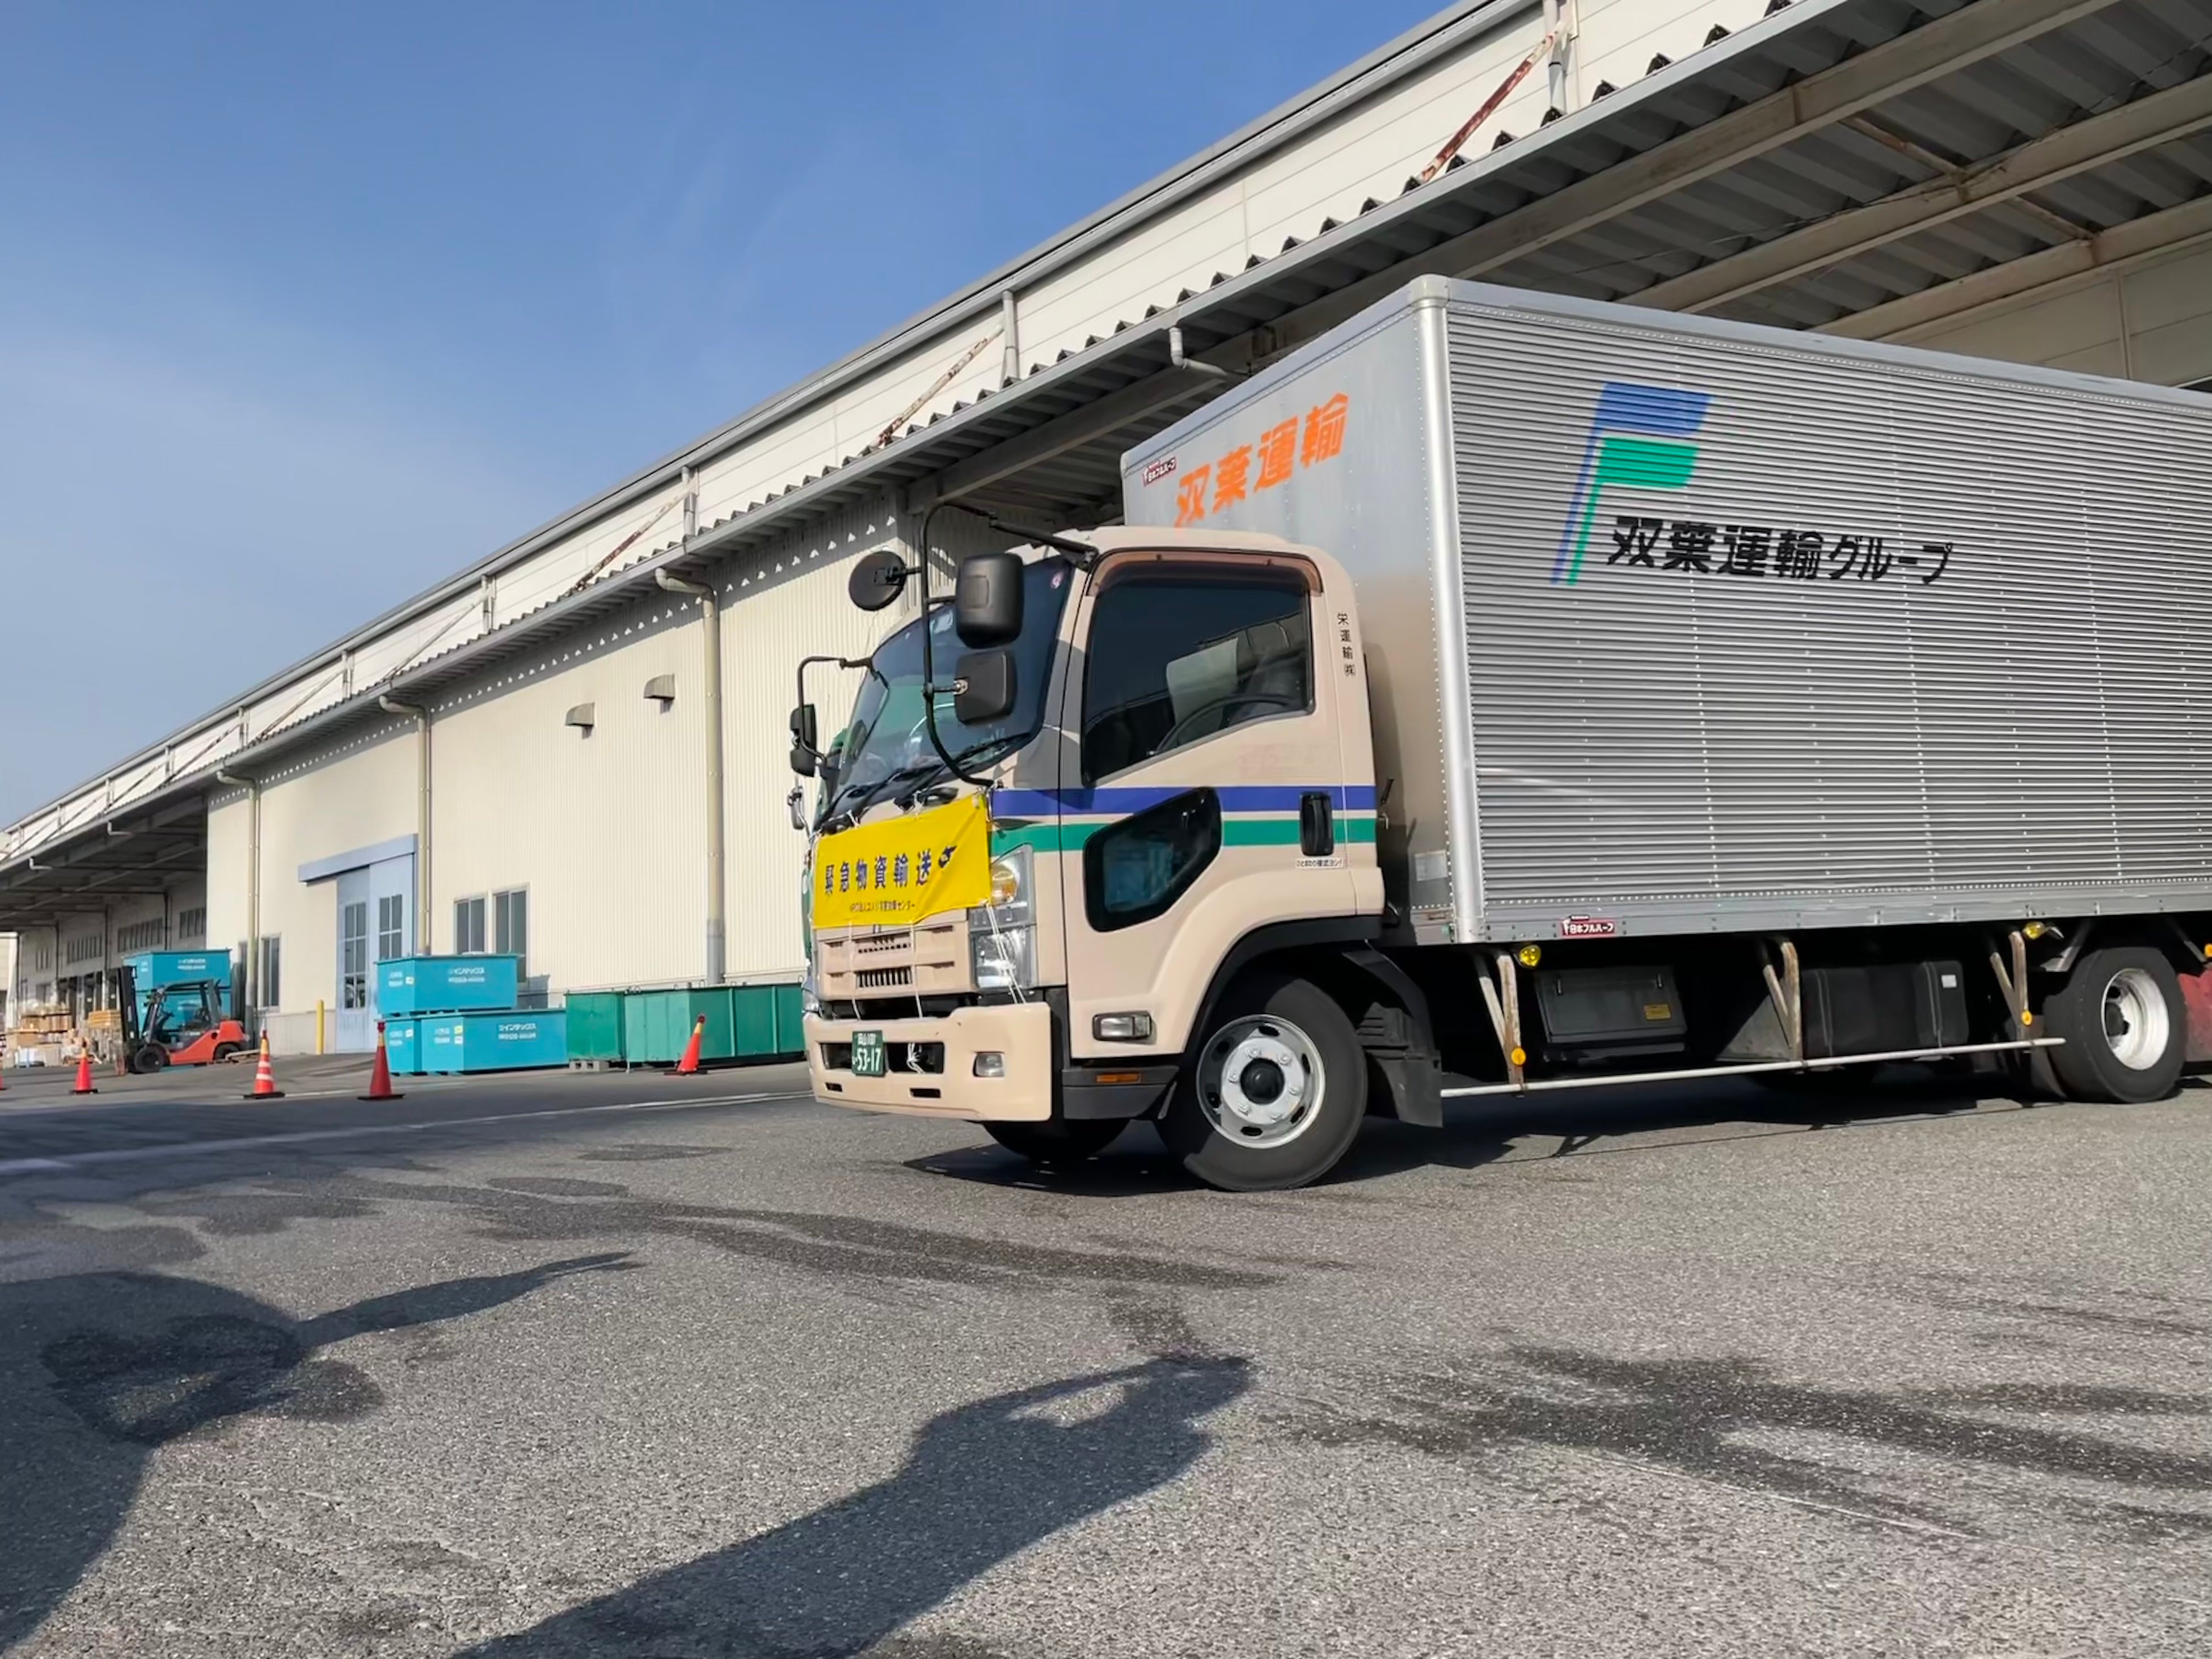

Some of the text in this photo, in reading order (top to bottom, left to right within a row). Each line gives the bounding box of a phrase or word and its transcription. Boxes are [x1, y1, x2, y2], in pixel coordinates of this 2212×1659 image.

[1174, 392, 1348, 529] 双葉運輸
[1607, 516, 1953, 584] 双葉運輸グループ
